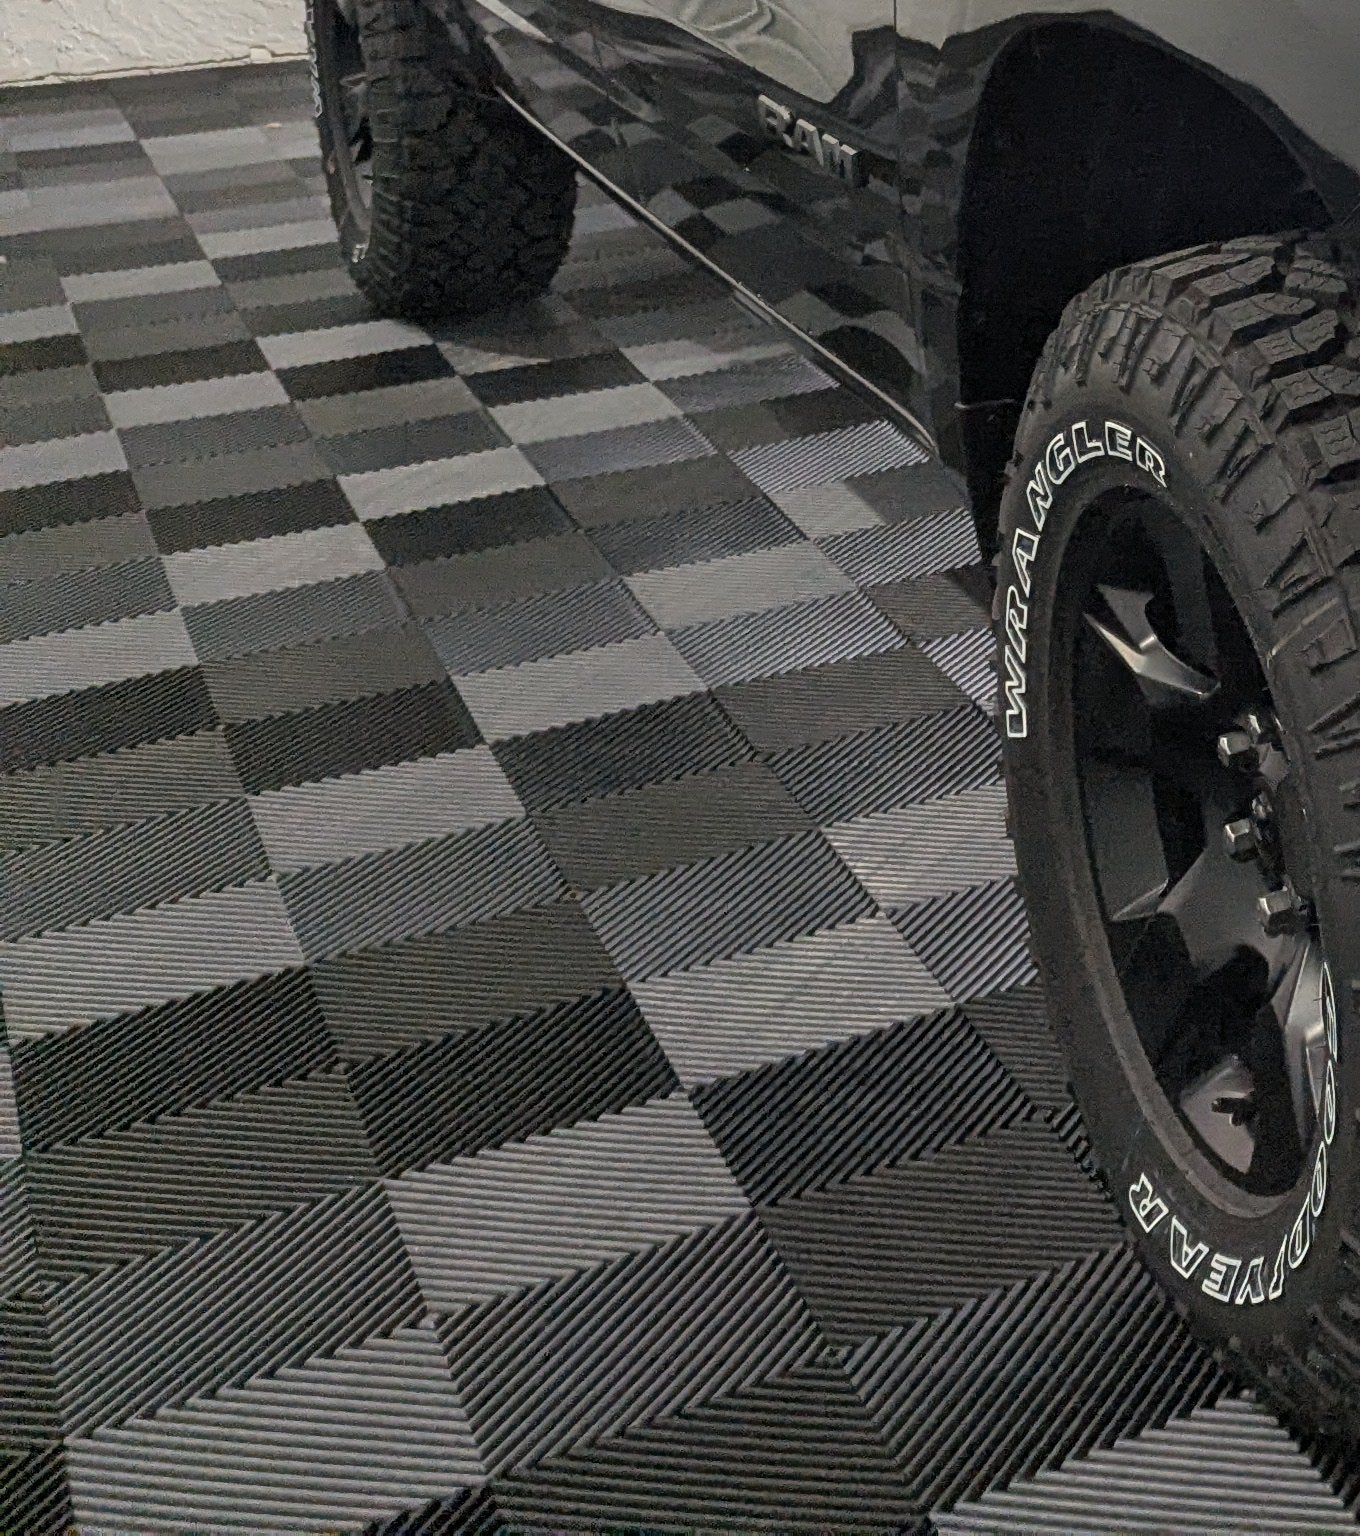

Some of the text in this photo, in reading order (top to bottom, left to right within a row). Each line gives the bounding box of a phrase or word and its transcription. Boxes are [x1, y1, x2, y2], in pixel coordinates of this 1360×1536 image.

[758, 94, 859, 183] RAM
[1004, 420, 1167, 739] WRANGLER
[1128, 961, 1338, 1305] GOODYEAR
